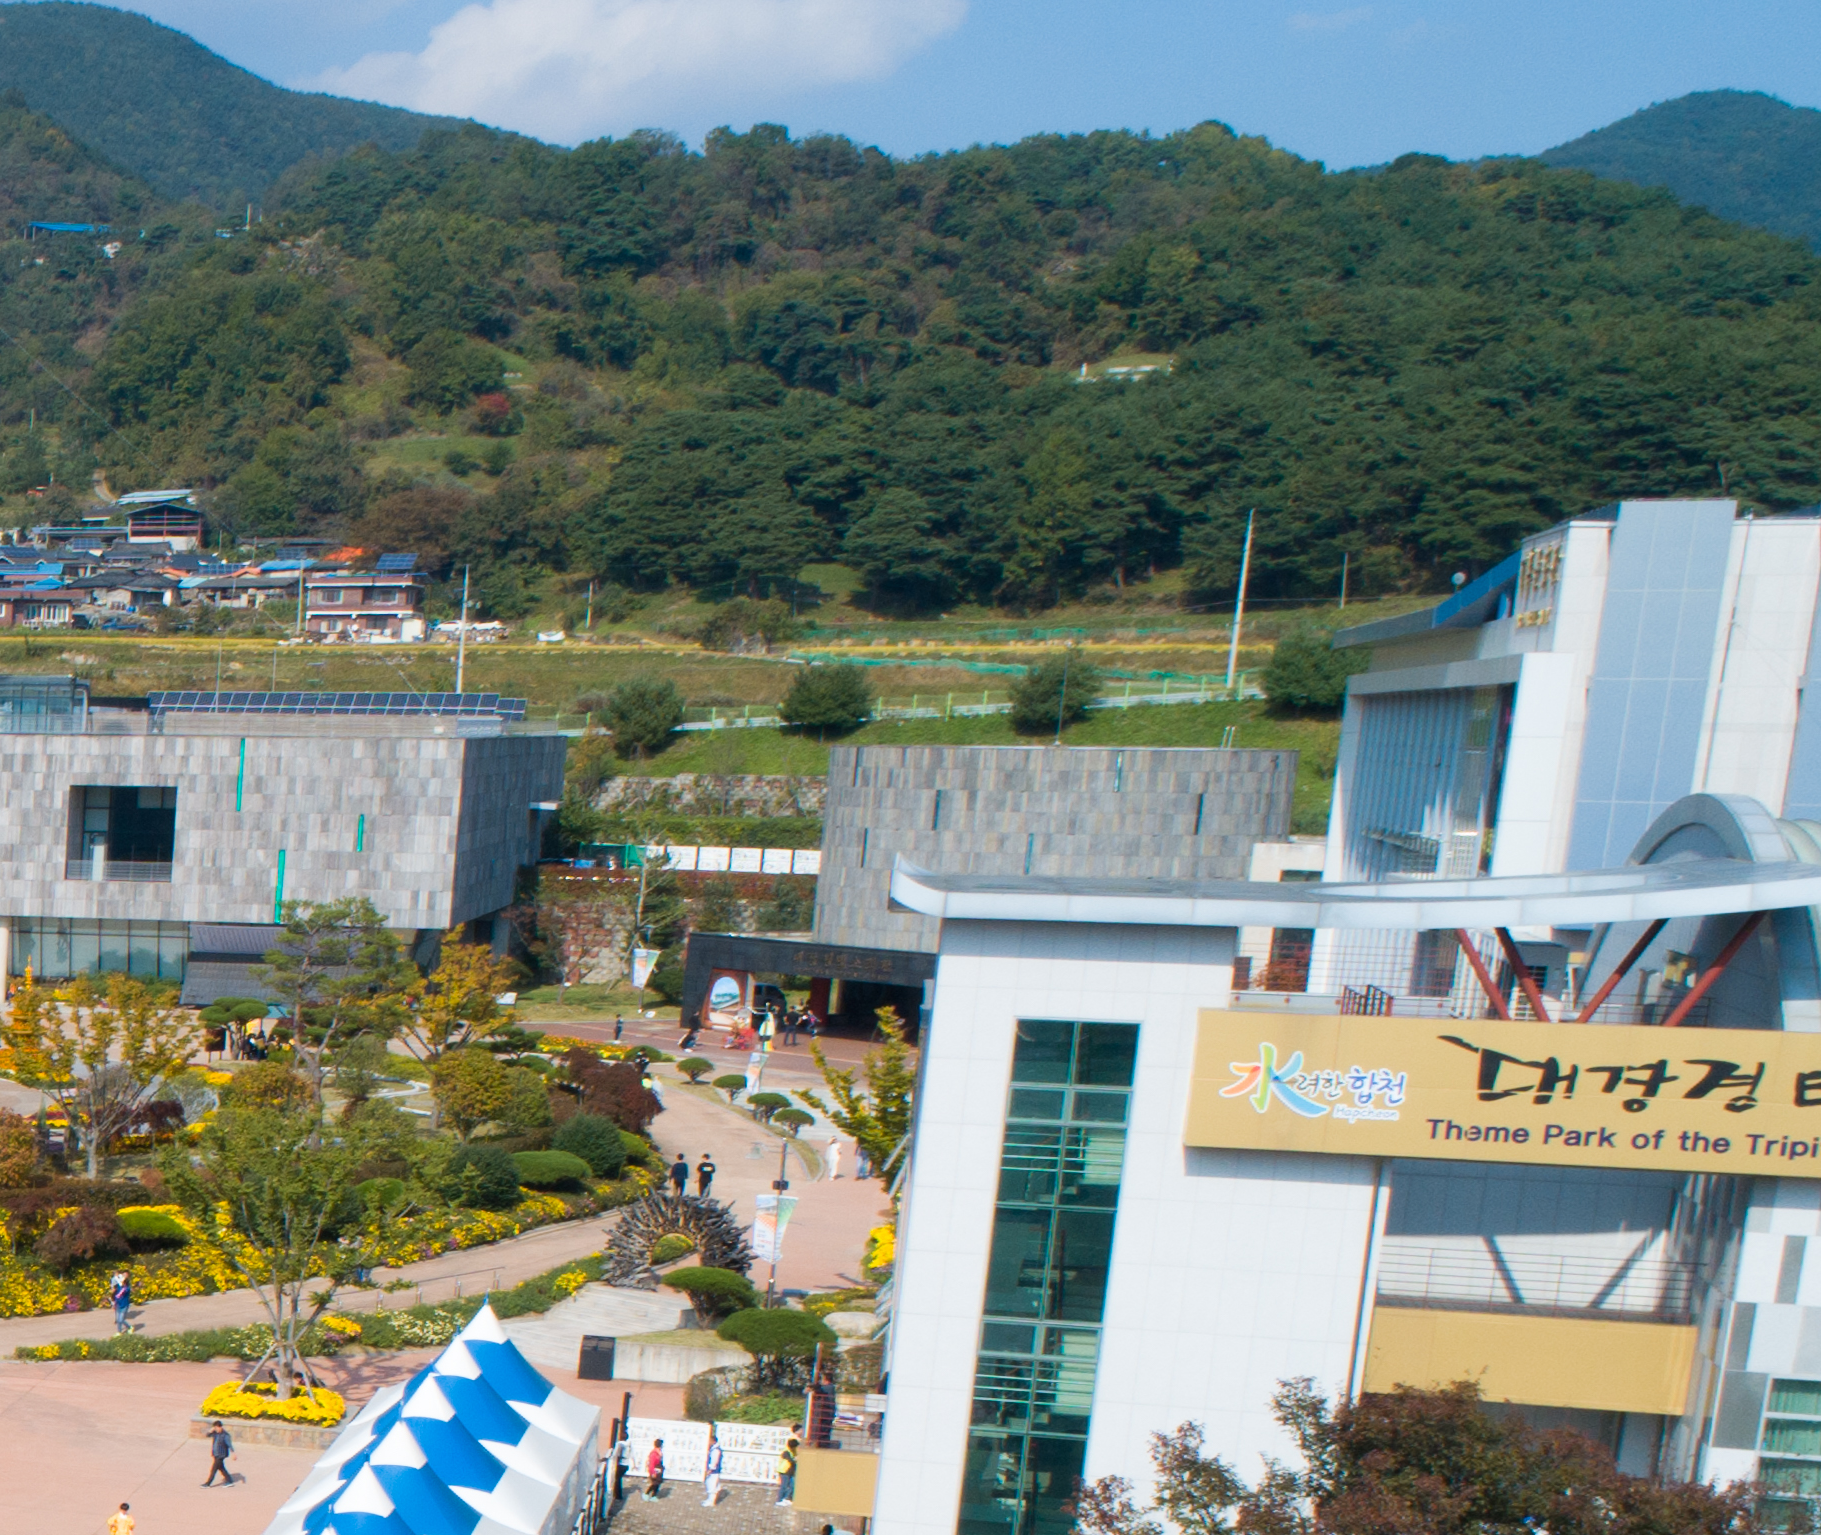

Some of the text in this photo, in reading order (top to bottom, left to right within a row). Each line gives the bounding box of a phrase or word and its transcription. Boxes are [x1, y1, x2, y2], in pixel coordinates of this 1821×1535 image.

[1426, 1117, 1531, 1145] Theme
[1543, 1123, 1618, 1149] Park
[1632, 1128, 1667, 1151] of
[1678, 1130, 1732, 1154] the
